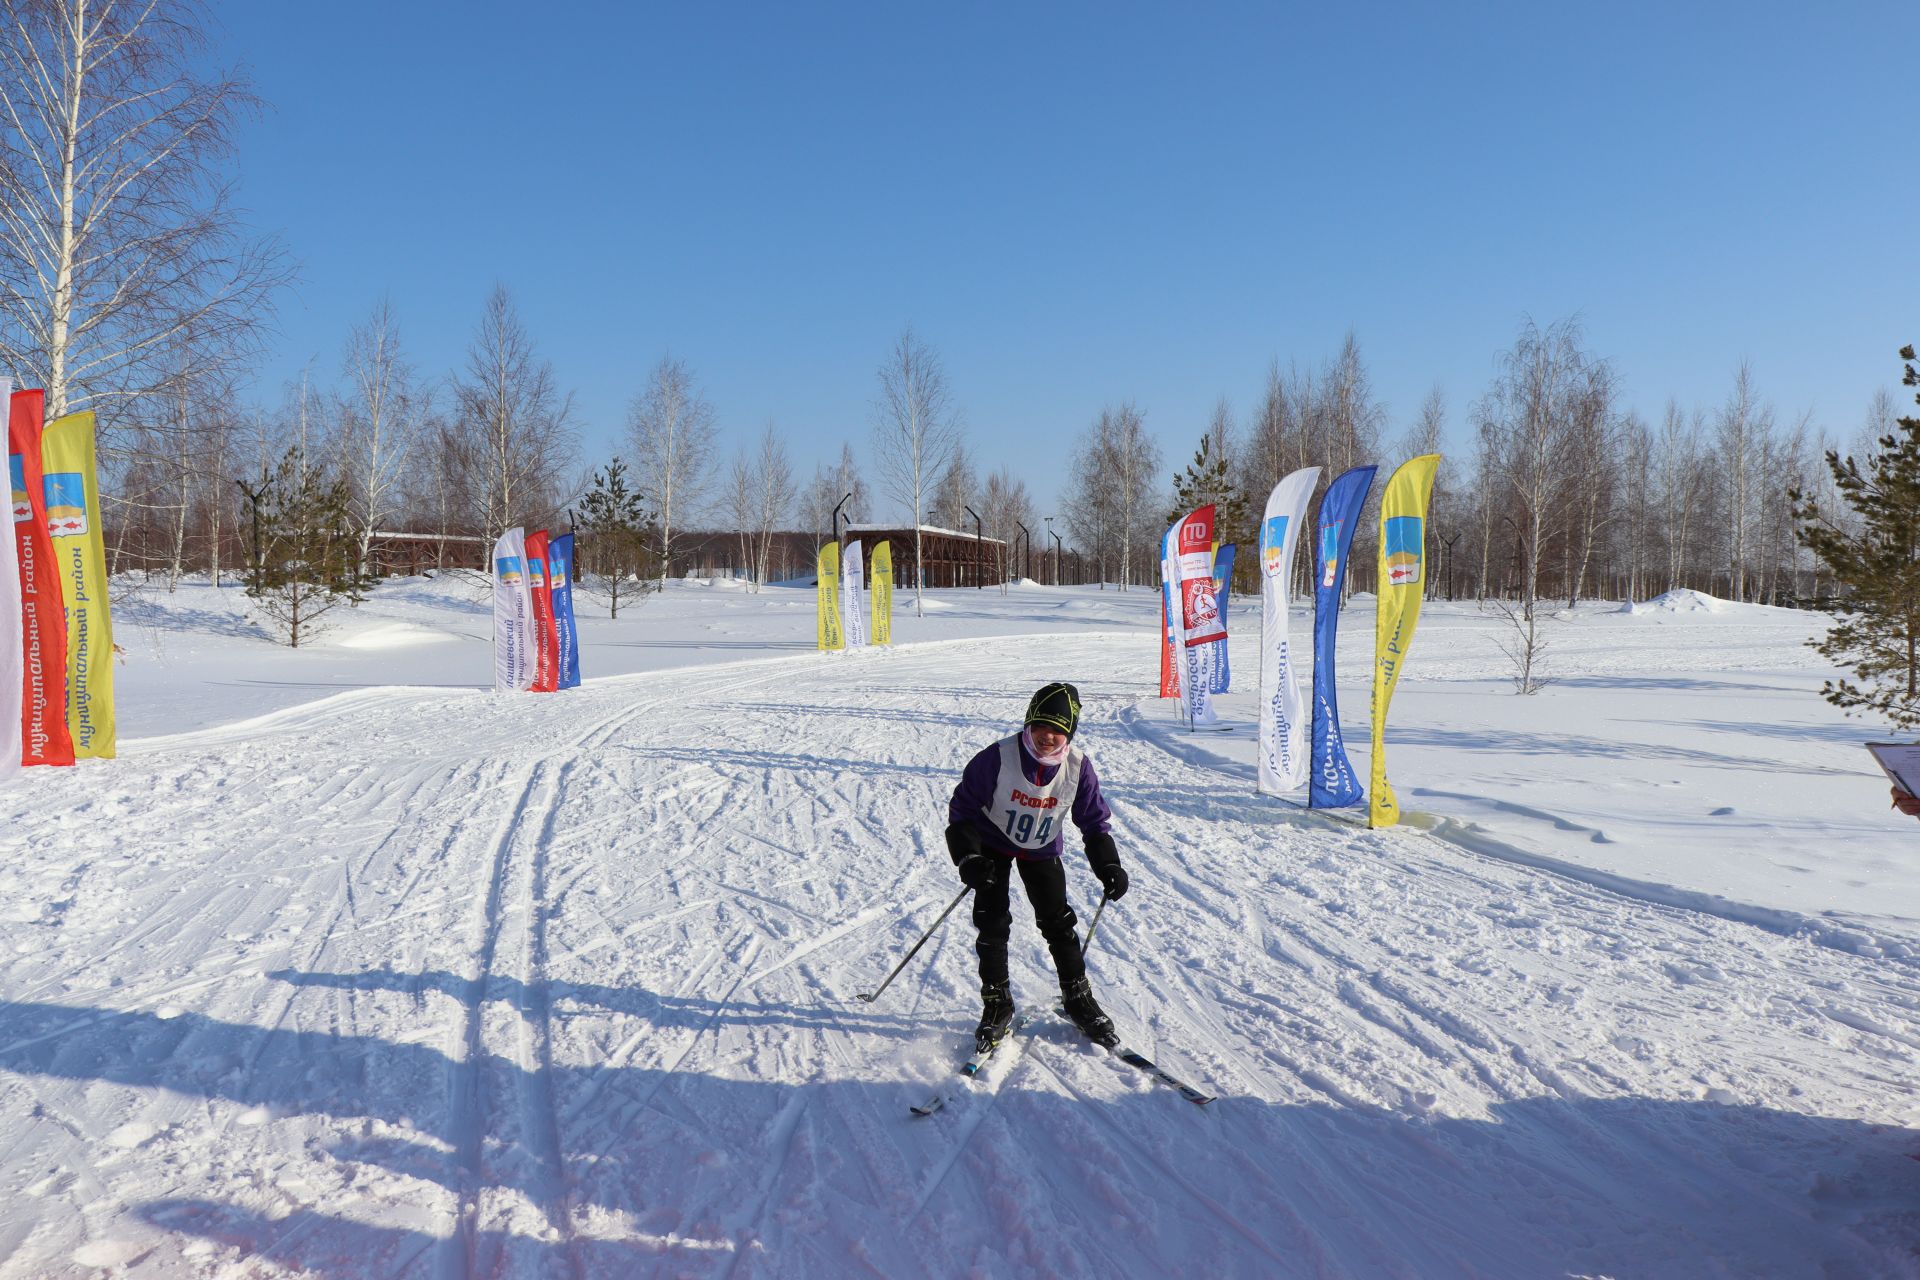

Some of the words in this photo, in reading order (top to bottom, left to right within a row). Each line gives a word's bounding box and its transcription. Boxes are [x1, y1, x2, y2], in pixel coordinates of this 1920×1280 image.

[22, 535, 38, 594] район
[70, 547, 90, 602] район
[25, 602, 49, 758] муниципальный
[73, 608, 96, 749] муниципальный
[1010, 788, 1058, 809] РСФСР
[1005, 810, 1053, 845] 194
